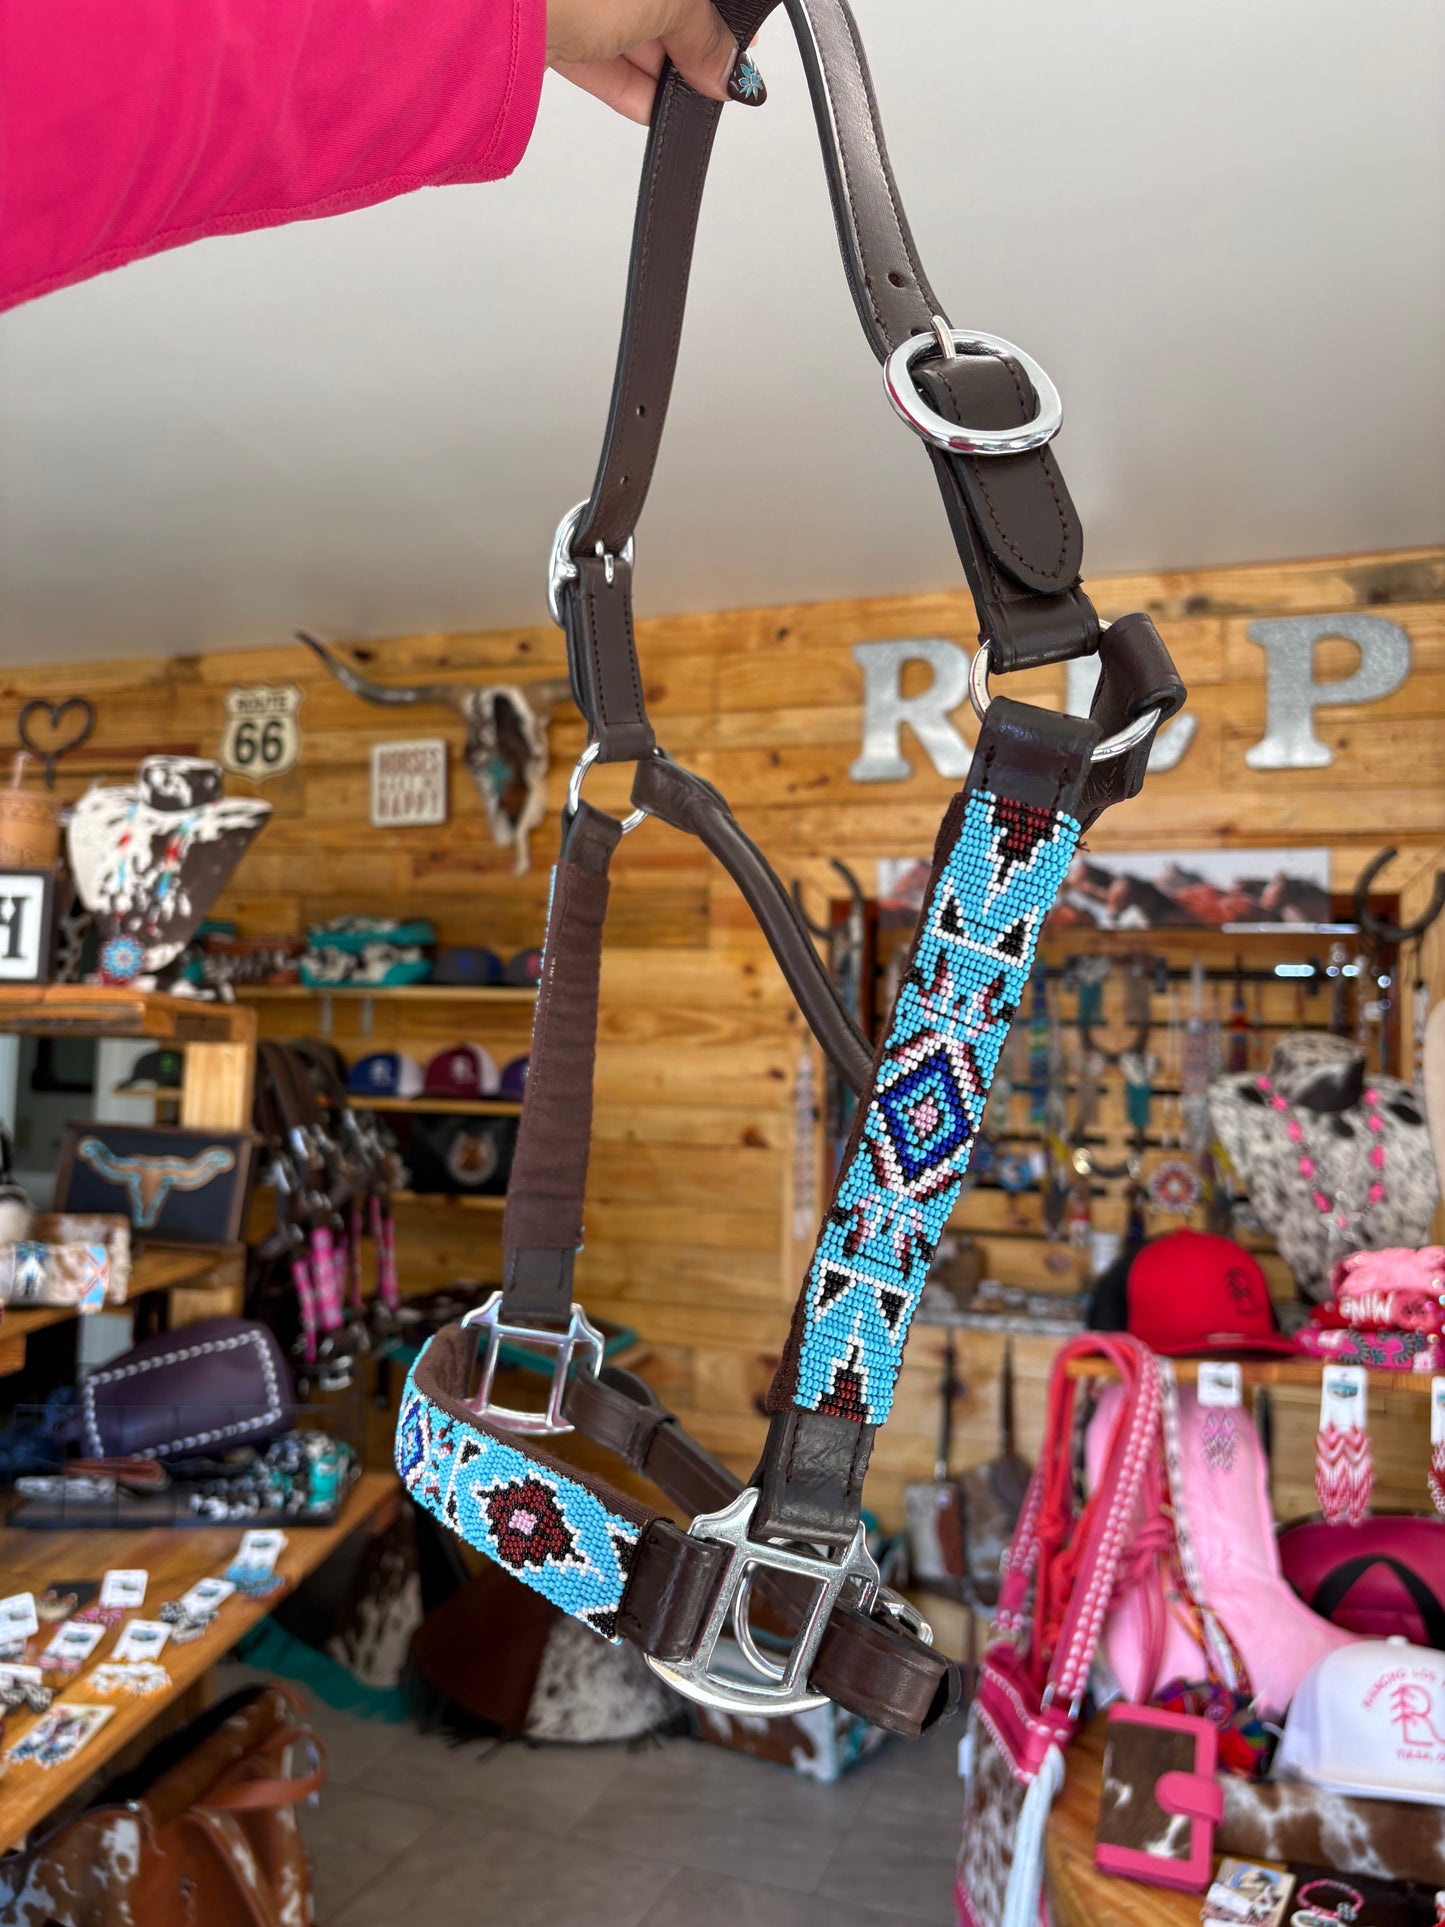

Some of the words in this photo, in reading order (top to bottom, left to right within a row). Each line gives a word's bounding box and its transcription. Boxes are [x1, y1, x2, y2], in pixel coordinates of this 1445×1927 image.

[236, 693, 287, 714] ROUTE
[234, 721, 284, 765] 66
[378, 792, 440, 818] HAPPY
